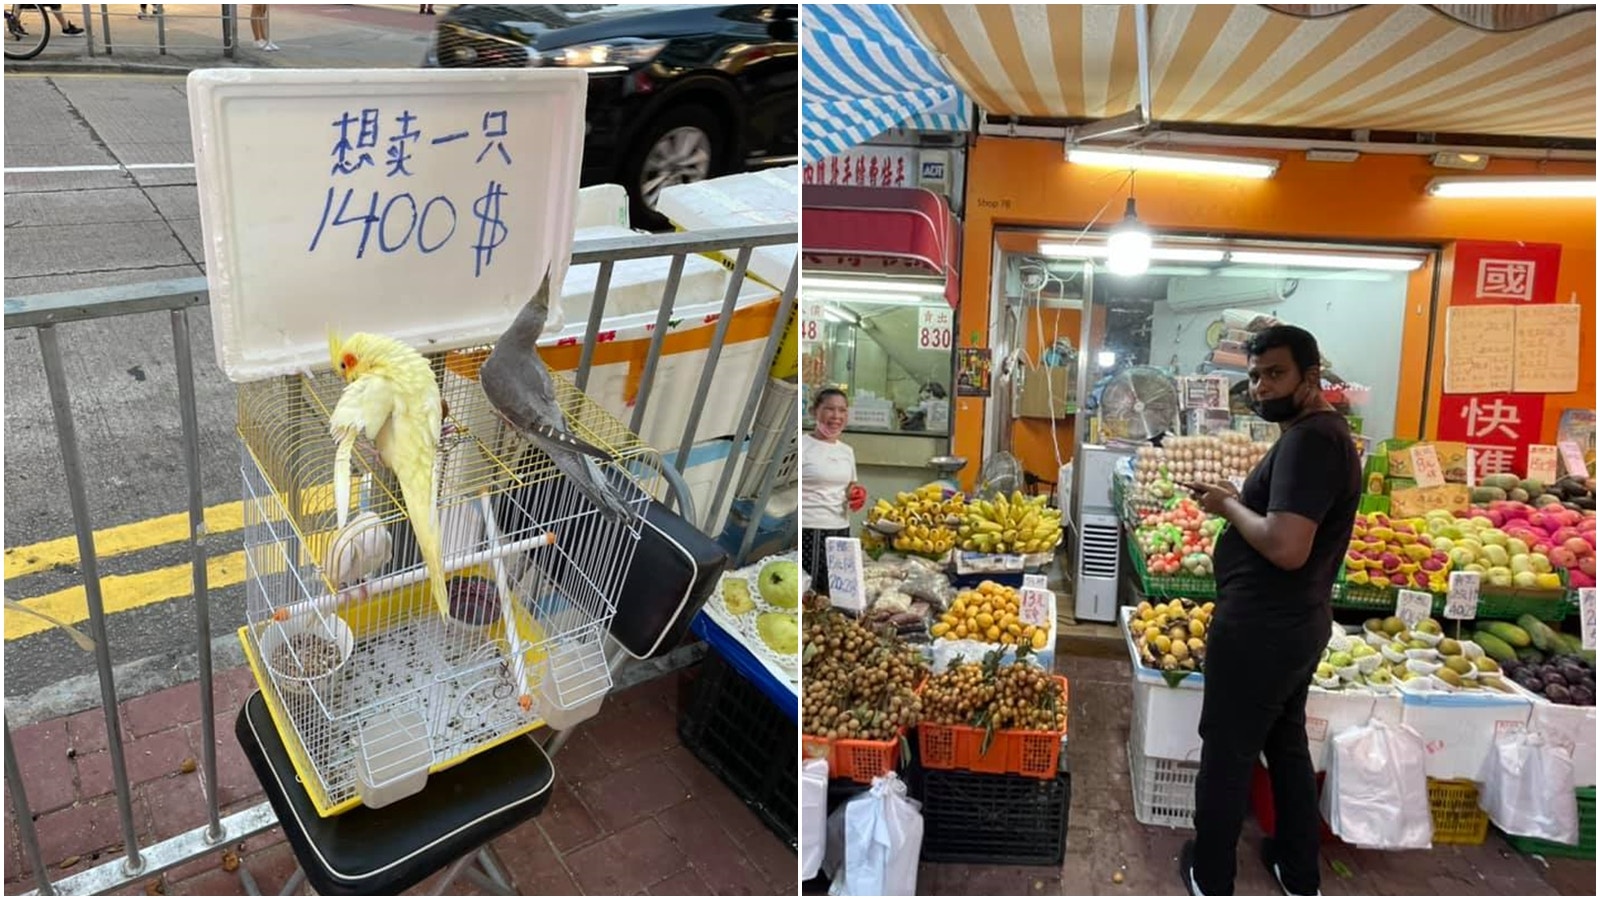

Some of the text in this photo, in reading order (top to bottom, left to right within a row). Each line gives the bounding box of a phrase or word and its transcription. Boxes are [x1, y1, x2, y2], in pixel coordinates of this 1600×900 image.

[331, 108, 512, 177] 想卖一只
[924, 164, 943, 178] ADT
[1476, 258, 1536, 302] 國
[921, 328, 950, 348] 830
